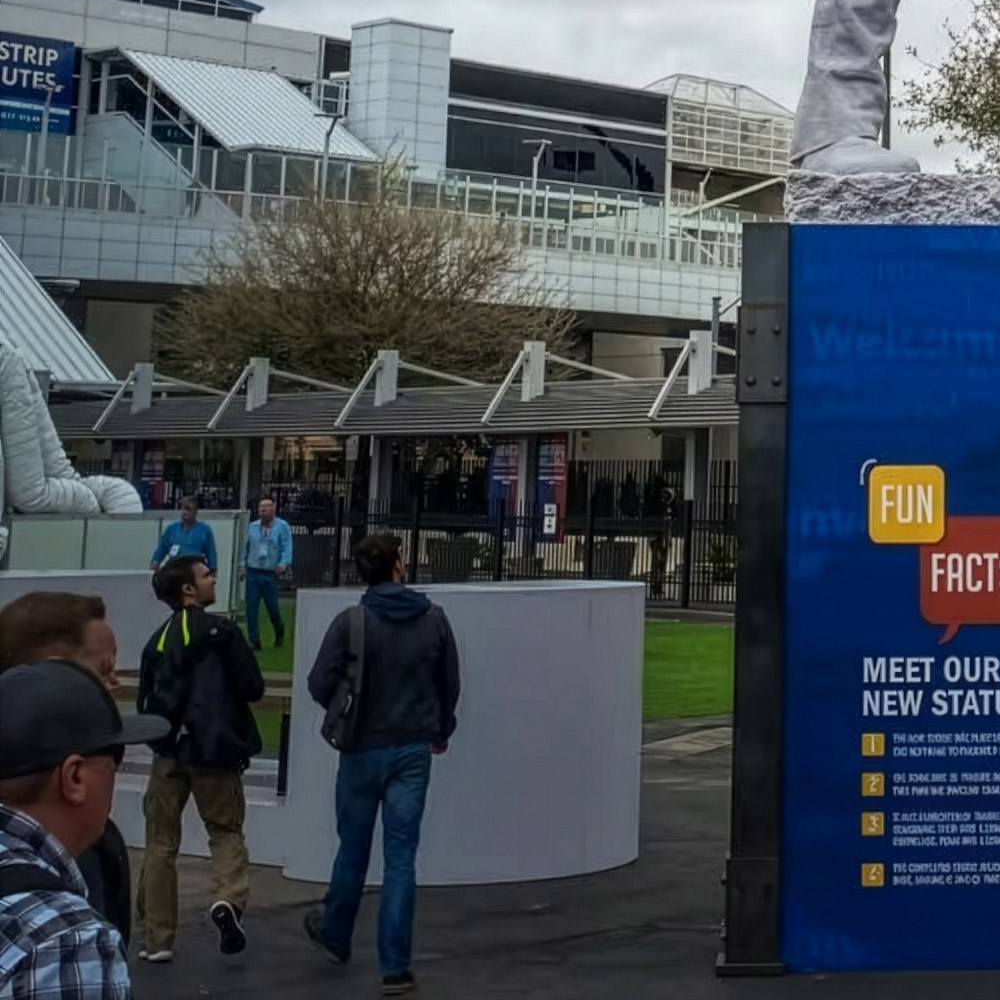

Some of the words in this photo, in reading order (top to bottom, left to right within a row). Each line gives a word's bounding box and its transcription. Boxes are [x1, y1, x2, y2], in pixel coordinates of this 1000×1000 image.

[0, 41, 59, 67] STRIP
[881, 484, 933, 524] FUN
[863, 656, 935, 683] MEET
[943, 655, 1000, 683] OUR
[863, 689, 923, 716] NEW
